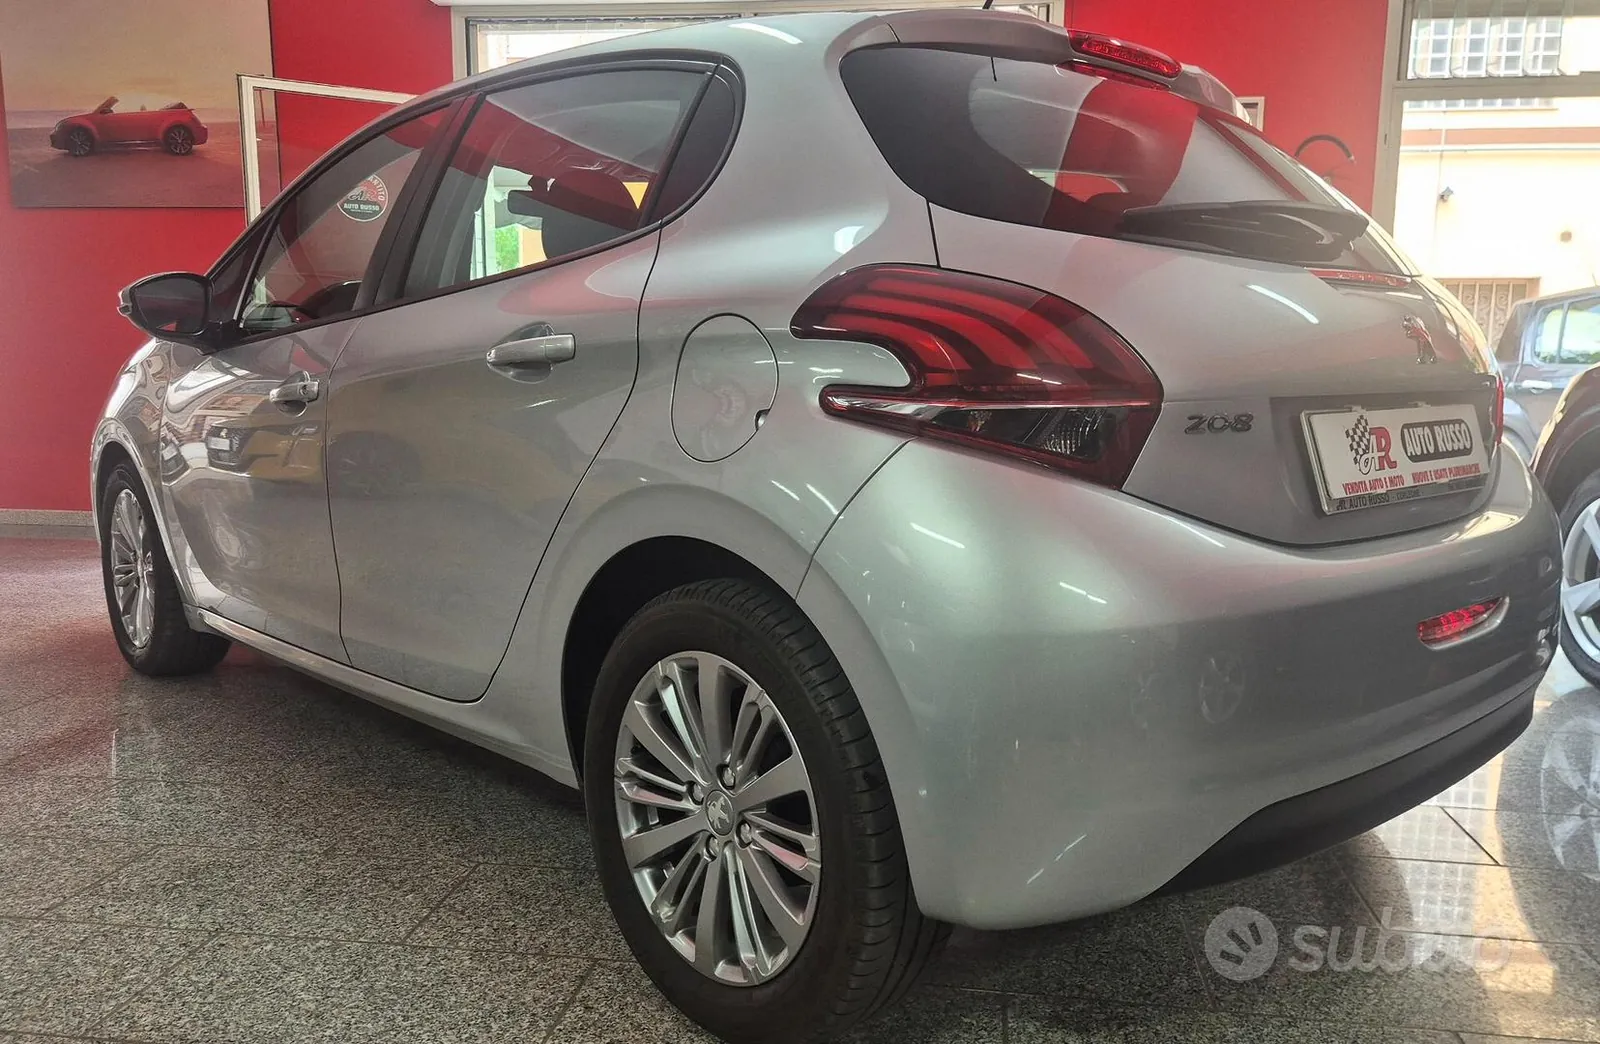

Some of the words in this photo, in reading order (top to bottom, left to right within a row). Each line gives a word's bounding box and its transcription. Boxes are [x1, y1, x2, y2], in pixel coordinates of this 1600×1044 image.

[1184, 413, 1254, 434] 208
[1403, 427, 1435, 457] AUTO
[1433, 423, 1471, 453] RUSSO
[1342, 480, 1369, 496] VENDITA
[1368, 477, 1384, 491] AUTO
[1383, 477, 1389, 489] E
[1388, 475, 1404, 488] MOTO
[1411, 470, 1430, 484] NUOVE
[1429, 470, 1434, 481] E
[1432, 468, 1449, 480] USATE
[1349, 496, 1367, 509] AUTO
[1368, 493, 1390, 506] RUSSO
